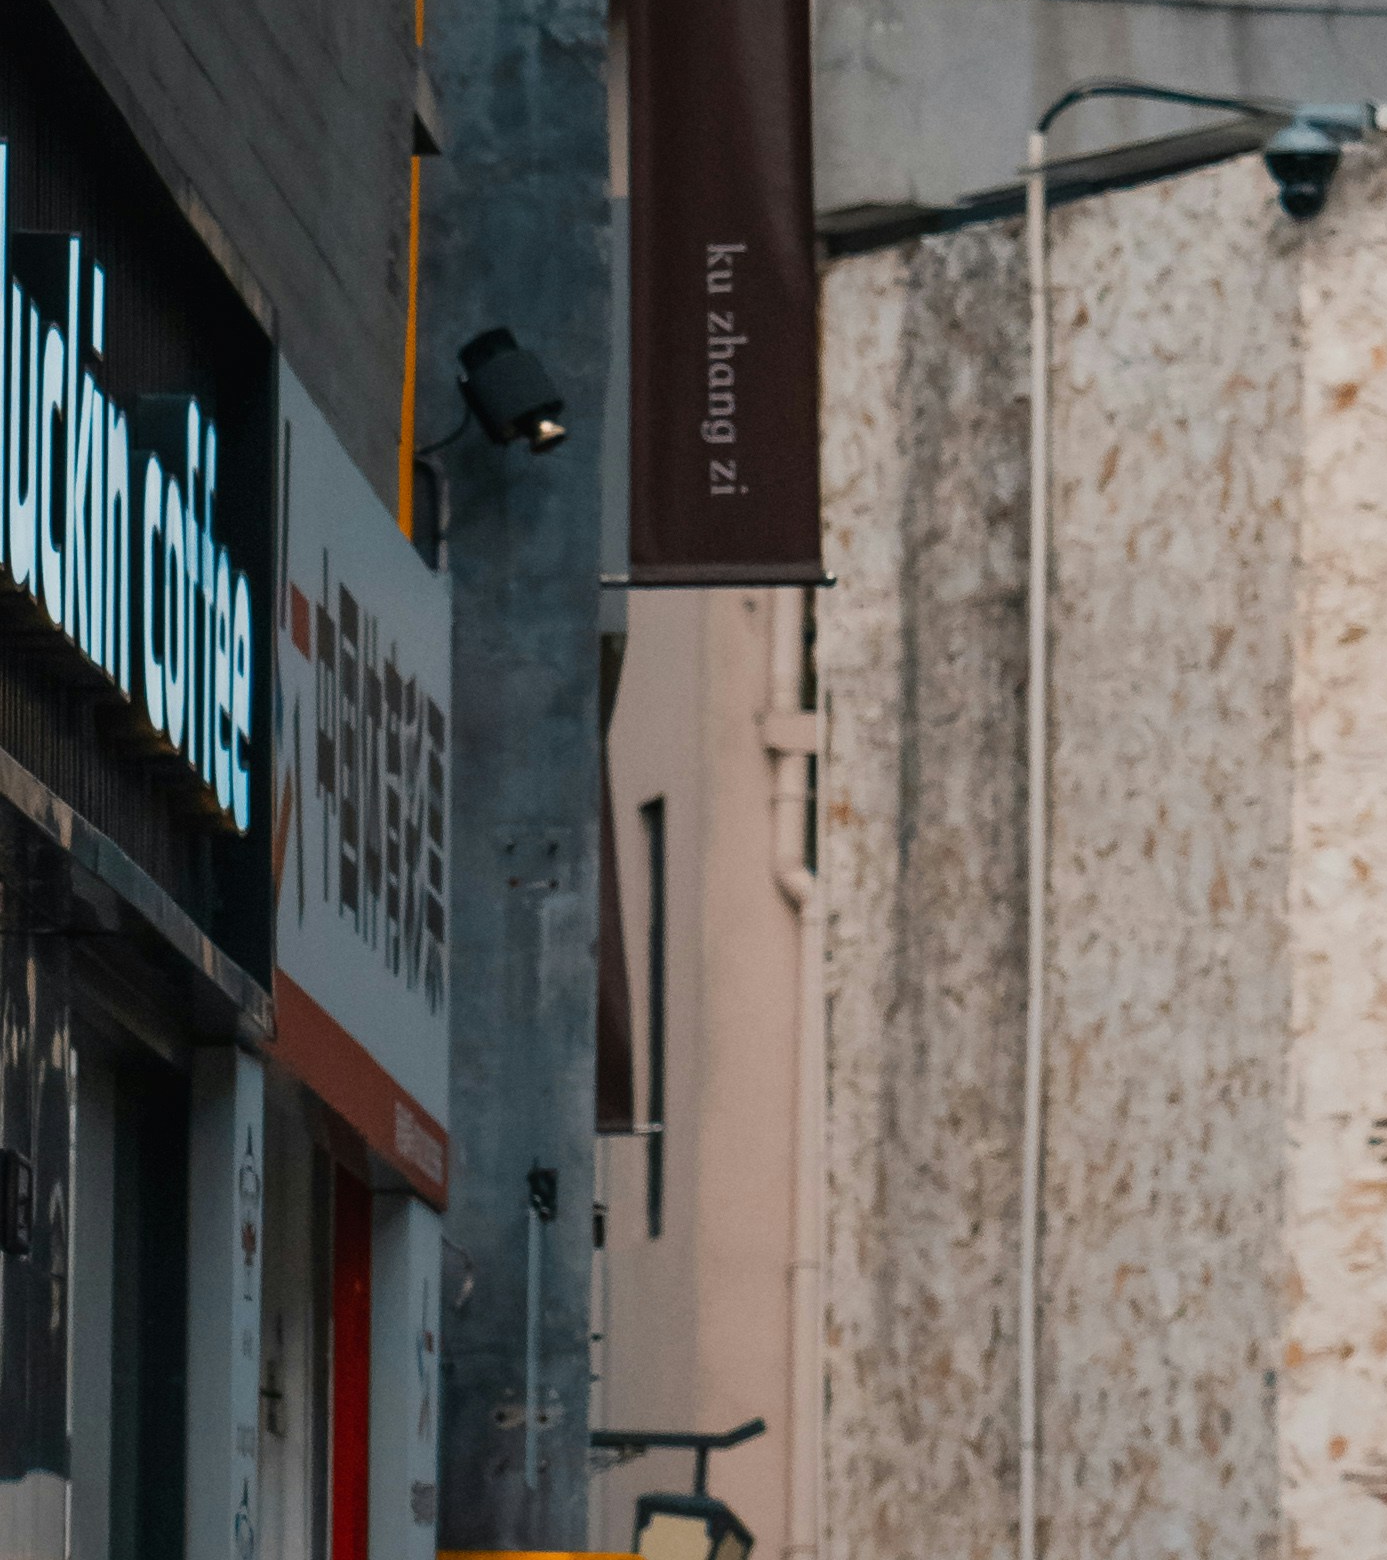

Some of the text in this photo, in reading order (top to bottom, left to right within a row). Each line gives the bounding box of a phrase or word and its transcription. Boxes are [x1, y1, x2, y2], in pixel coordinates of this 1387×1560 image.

[700, 243, 749, 496] ku zhang zi
[142, 393, 253, 838] coffee
